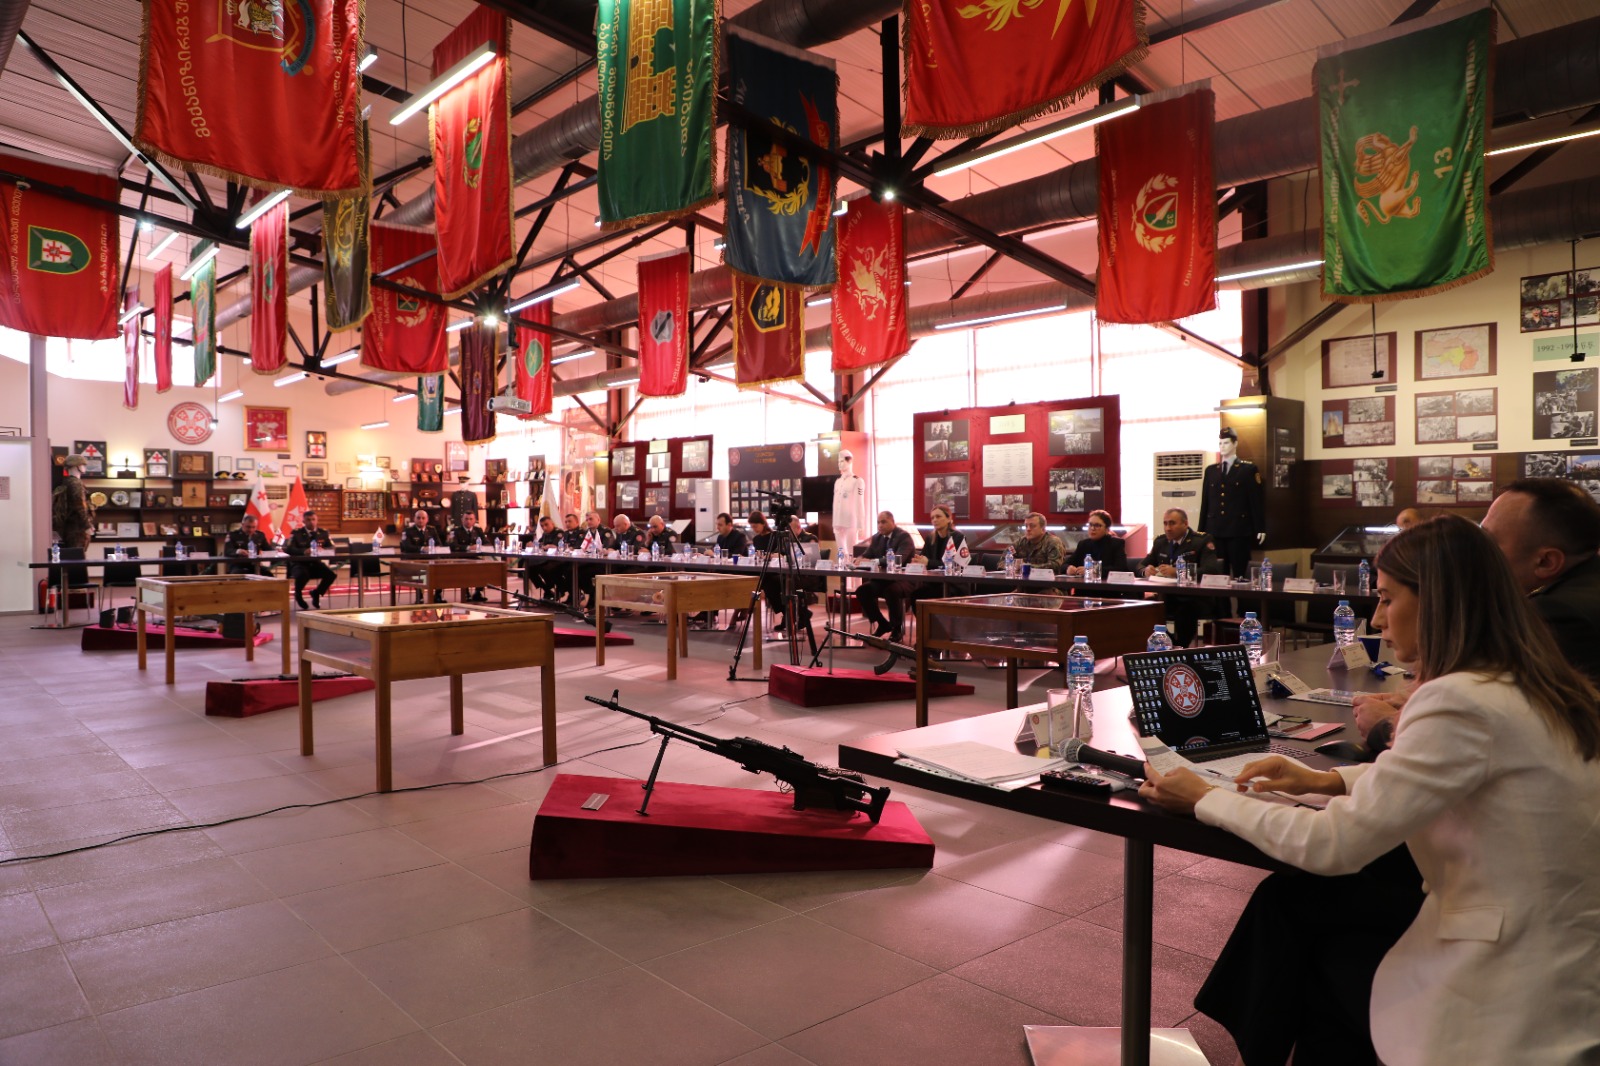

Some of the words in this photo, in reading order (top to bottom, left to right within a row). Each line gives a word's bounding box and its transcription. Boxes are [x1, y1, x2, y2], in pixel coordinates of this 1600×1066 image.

[597, 22, 611, 111] ბატალიო
[1433, 145, 1454, 179] 13
[1166, 213, 1174, 225] 32
[1538, 344, 1554, 352] 1992
